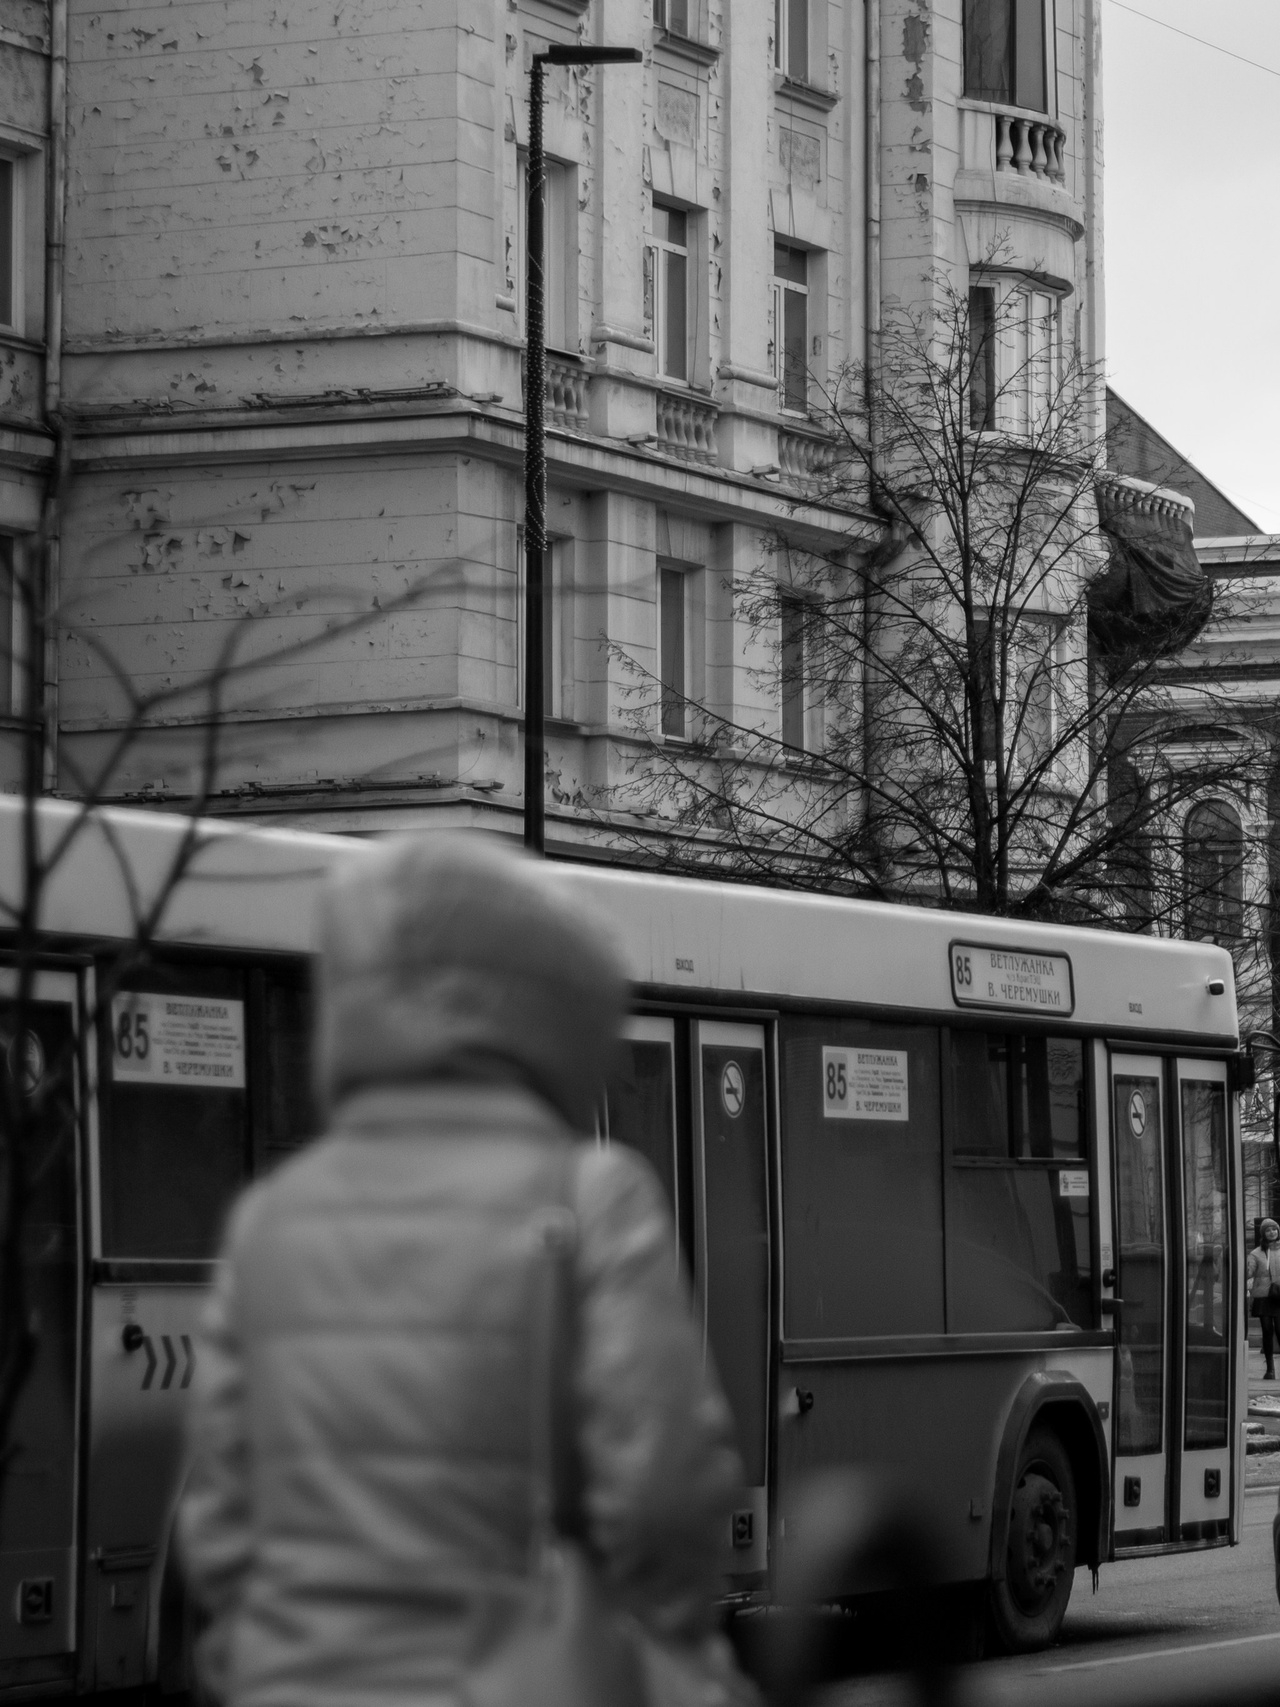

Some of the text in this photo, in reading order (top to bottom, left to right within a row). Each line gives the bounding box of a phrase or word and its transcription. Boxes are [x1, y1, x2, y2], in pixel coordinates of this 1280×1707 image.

[676, 958, 694, 973] ВХОД
[956, 955, 972, 985] 85
[990, 953, 1055, 976] ВЕТЛУЖАНКА
[988, 982, 1060, 1005] В. ЧЕРЕМУШКИ
[117, 1010, 149, 1060] 85
[857, 1053, 899, 1067] ВЕТЛУЖАНКА
[826, 1062, 847, 1100] 85
[864, 1101, 902, 1113] ЧЕРЕМУШКИ
